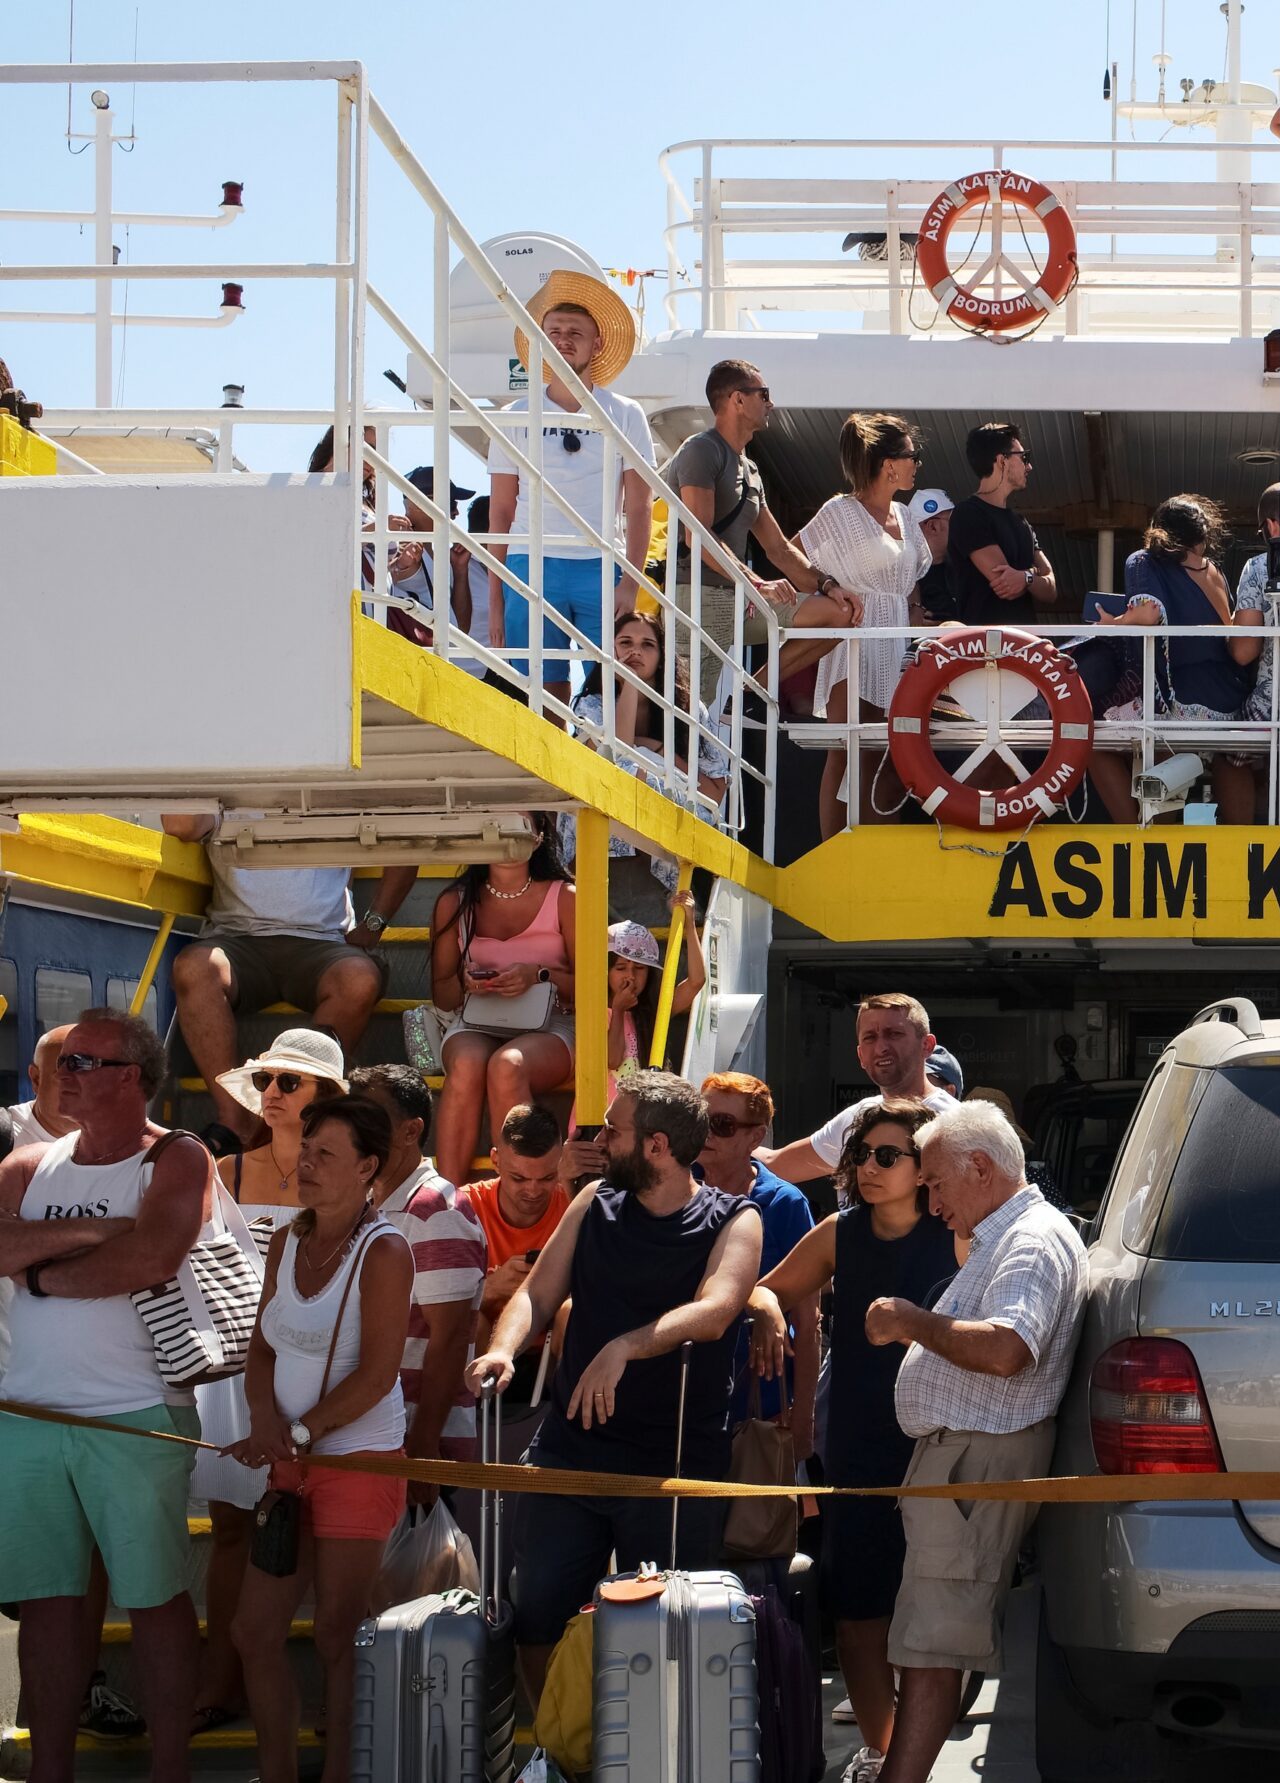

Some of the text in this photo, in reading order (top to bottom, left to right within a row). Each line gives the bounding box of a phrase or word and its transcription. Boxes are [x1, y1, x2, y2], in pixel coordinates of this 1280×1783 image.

[926, 197, 954, 242] ASIM
[505, 248, 533, 256] SOLAS
[953, 295, 1032, 315] BODRUM
[1001, 641, 1071, 701] KAPTAN
[996, 763, 1075, 817] BODUM
[989, 841, 1207, 919] ASIM
